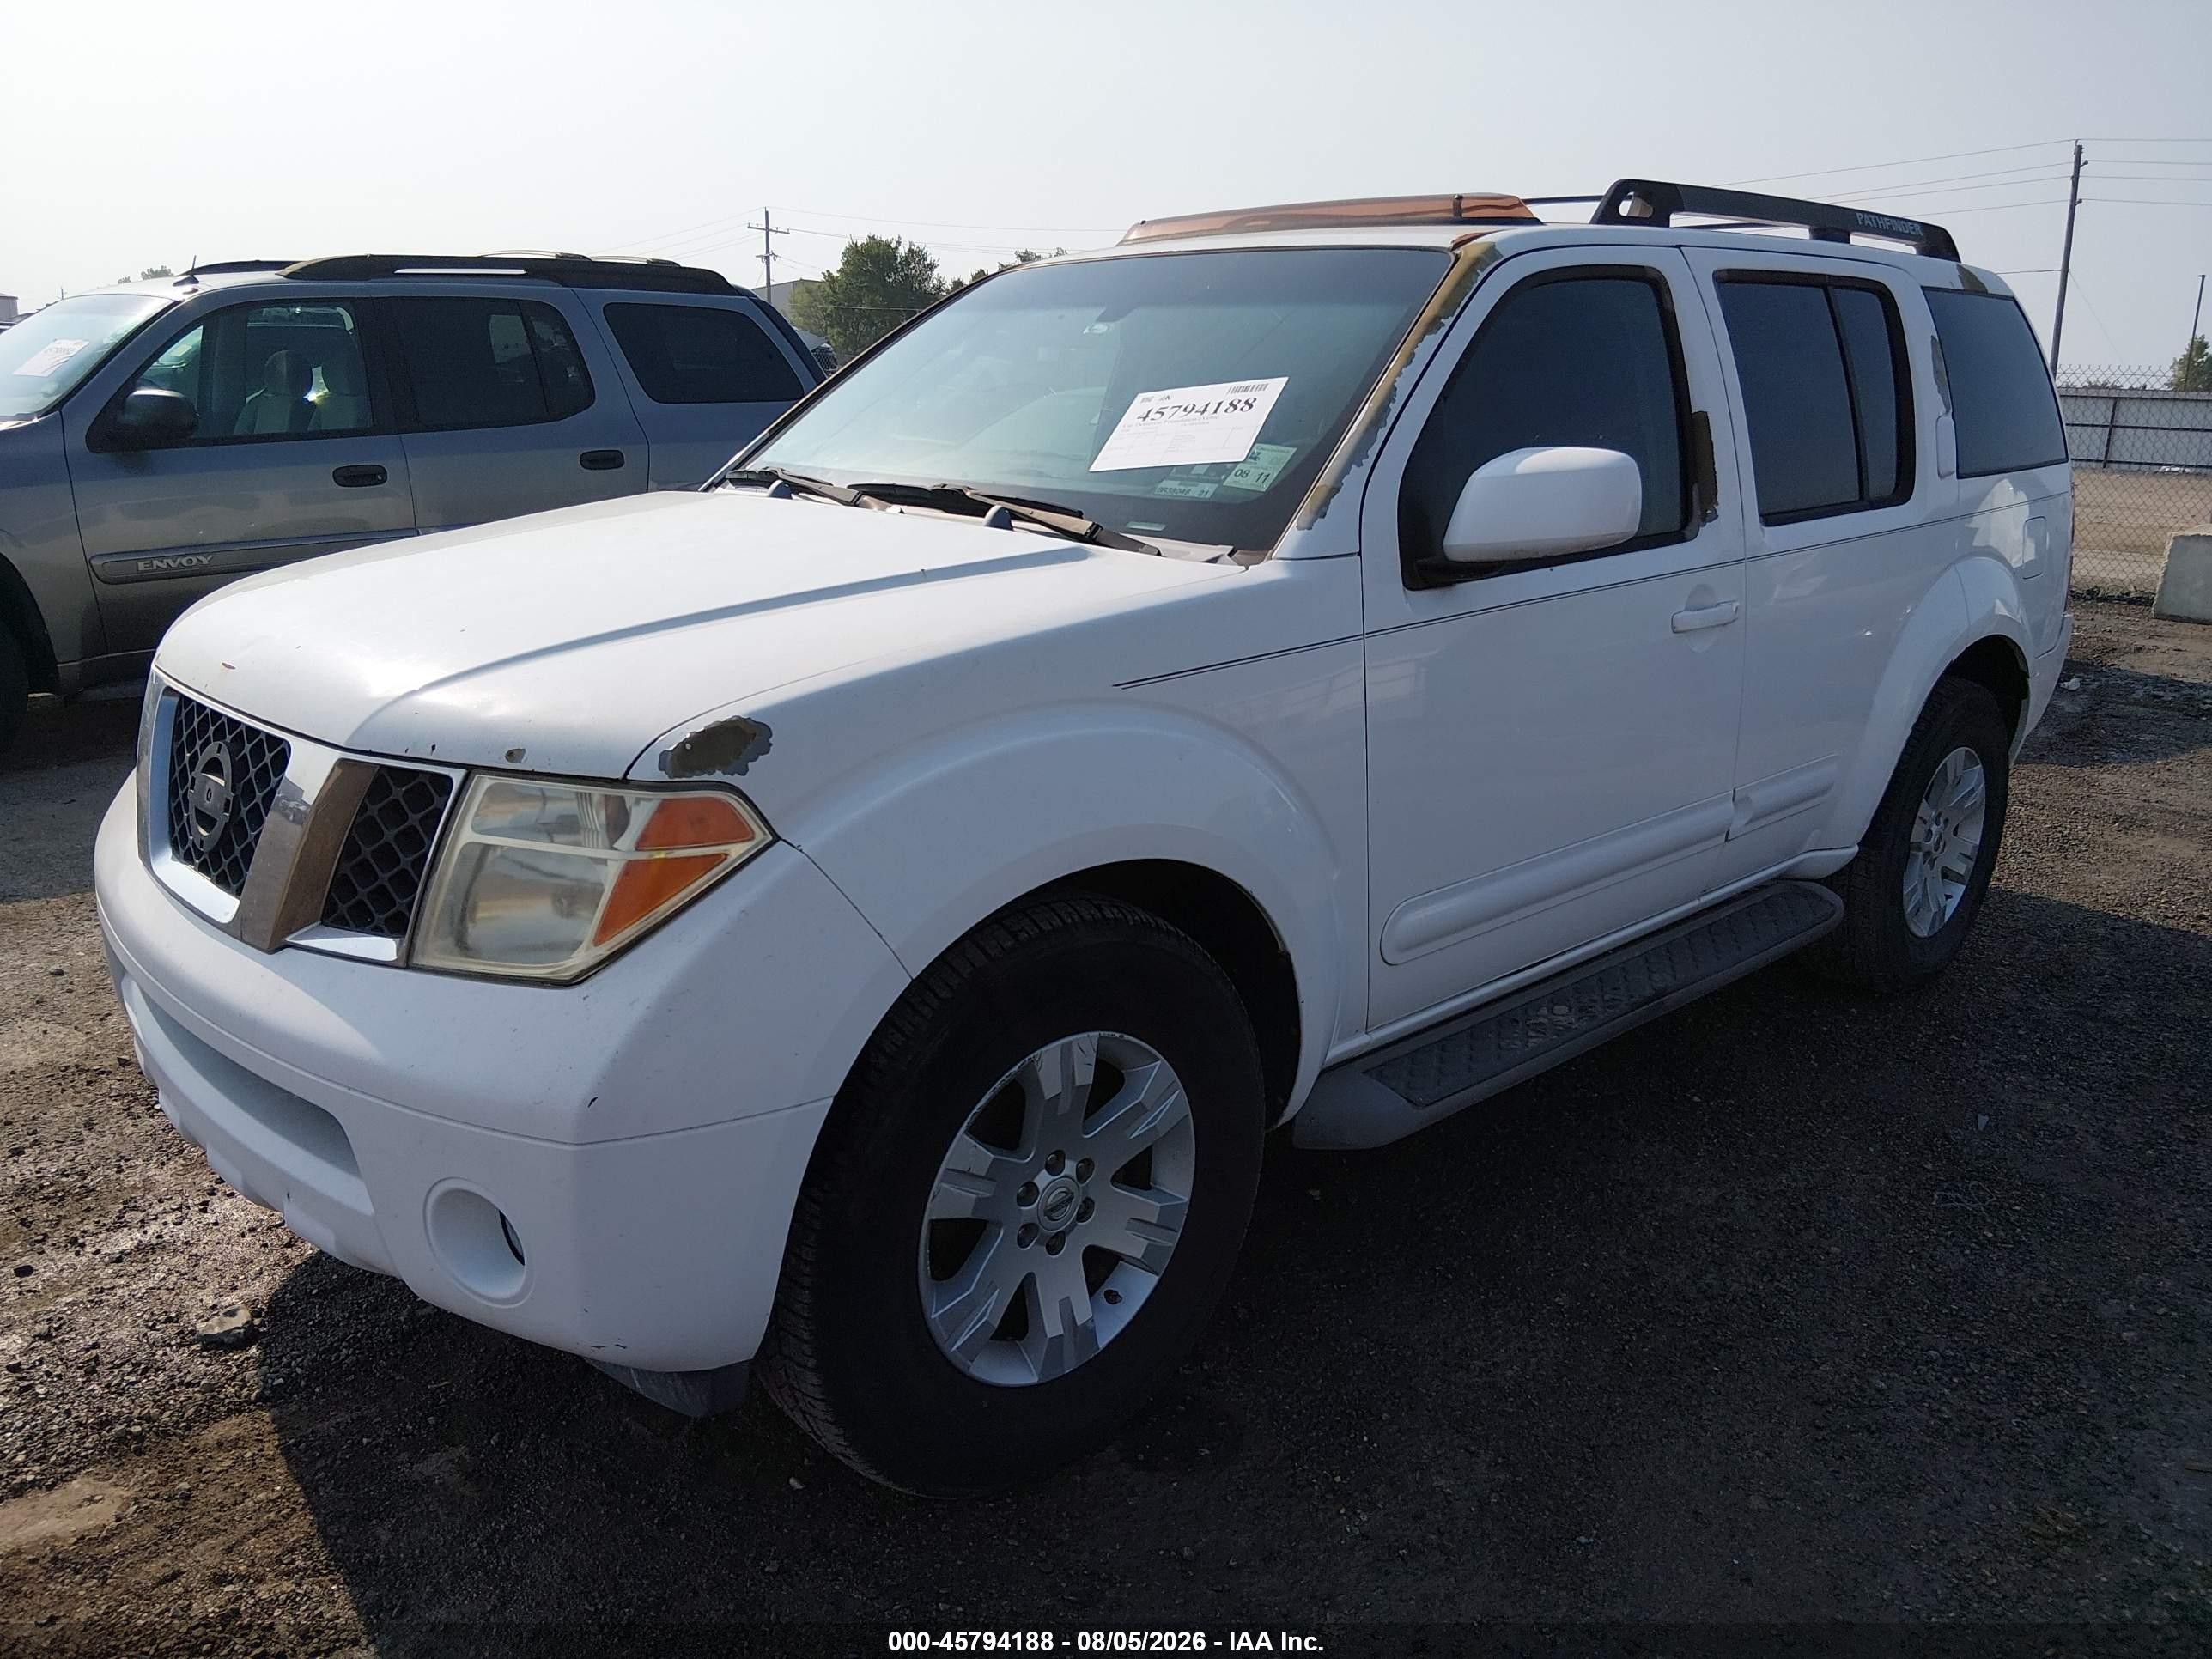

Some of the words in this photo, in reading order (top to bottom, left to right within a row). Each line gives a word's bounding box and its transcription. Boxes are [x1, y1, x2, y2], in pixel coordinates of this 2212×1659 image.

[1856, 212, 1923, 236] PATHFINDER
[1137, 397, 1257, 422] 45794188
[1234, 469, 1251, 478] 08
[1255, 472, 1271, 484] 11
[137, 555, 214, 571] ENVOY
